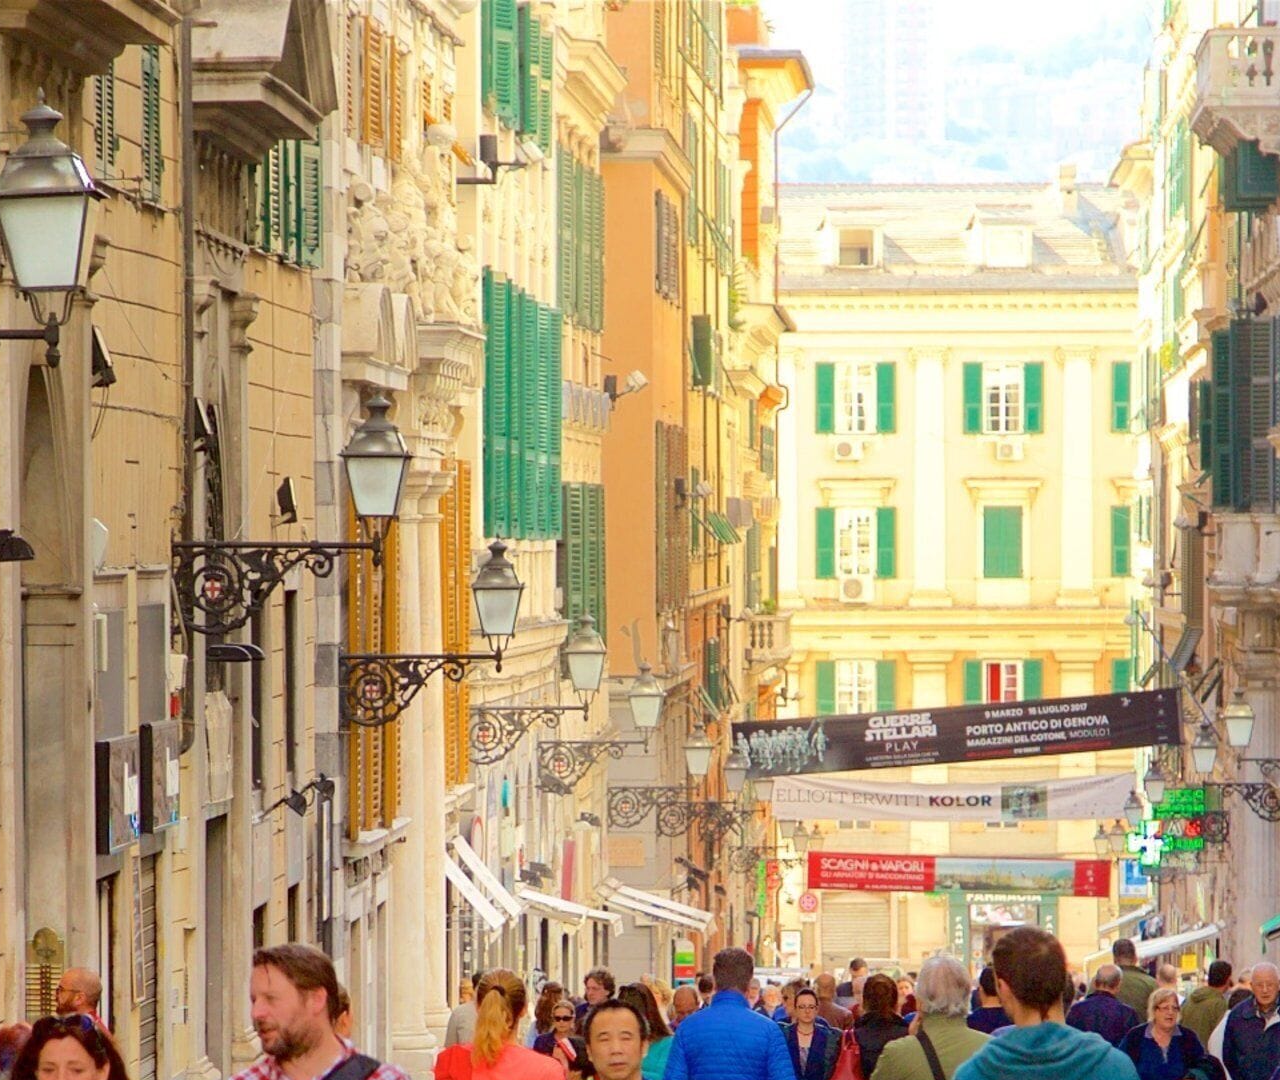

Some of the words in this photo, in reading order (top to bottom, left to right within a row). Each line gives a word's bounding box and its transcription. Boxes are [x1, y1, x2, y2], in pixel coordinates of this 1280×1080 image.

[991, 707, 1024, 719] MARZO
[1038, 704, 1070, 716] LUGLIO
[868, 713, 932, 729] GUERRE
[966, 722, 1004, 736] PORTO
[1004, 720, 1048, 734] ANTICO
[1049, 719, 1062, 730] DI
[1063, 714, 1110, 729] GENOVA
[864, 724, 938, 743] STELLARI
[966, 736, 1014, 748] MAGAZZINI
[1014, 734, 1030, 744] DEL
[1069, 729, 1106, 740] MODULO
[885, 740, 920, 752] PLAY
[775, 788, 850, 805] ELLIOTT
[851, 791, 926, 807] ERWITT
[928, 794, 993, 808] KOLOR
[820, 857, 869, 871] SCAGNI
[879, 859, 925, 873] VAPORI
